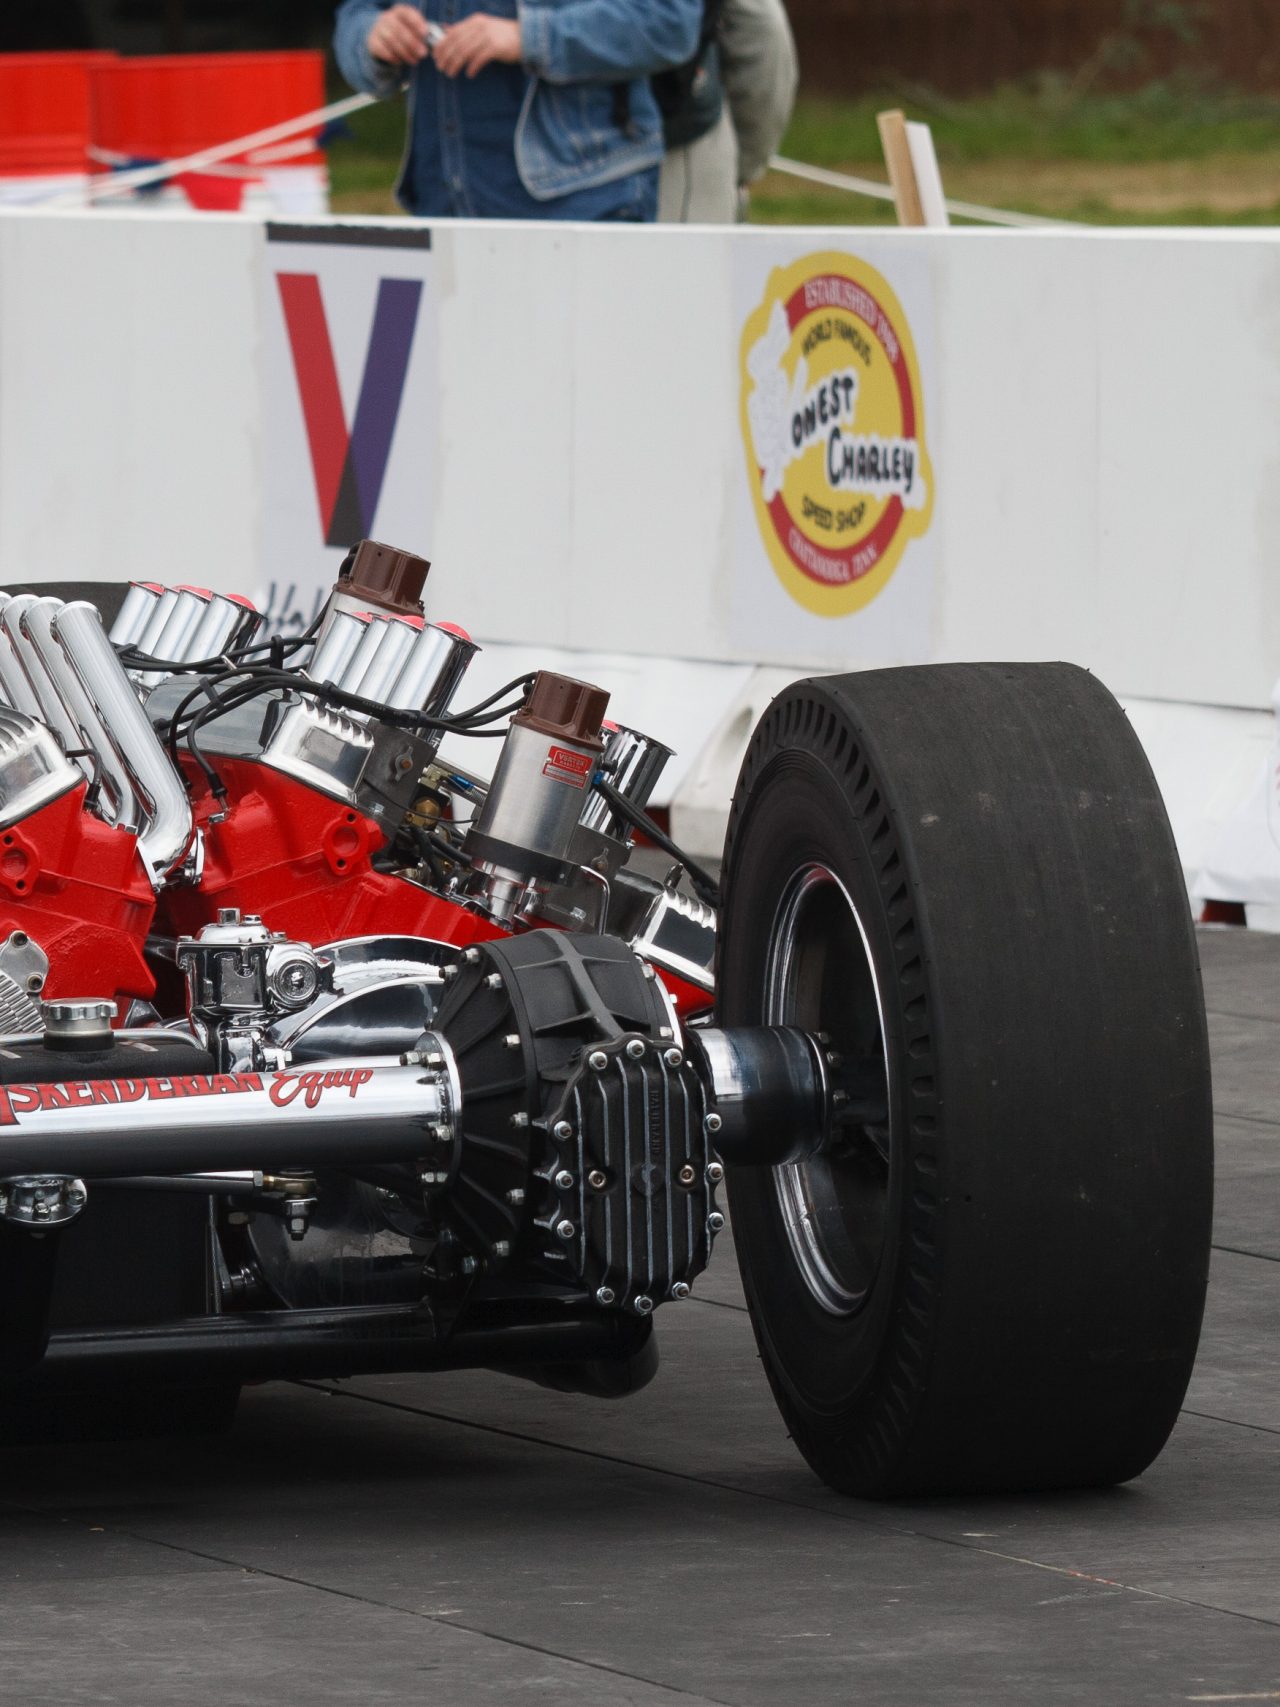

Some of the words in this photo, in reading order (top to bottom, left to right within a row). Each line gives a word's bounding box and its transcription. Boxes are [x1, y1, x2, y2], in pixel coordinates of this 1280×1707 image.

[828, 426, 915, 493] CHARLEY
[802, 496, 833, 531] SPEED
[836, 501, 866, 532] SHOP
[269, 1068, 375, 1109] Equip
